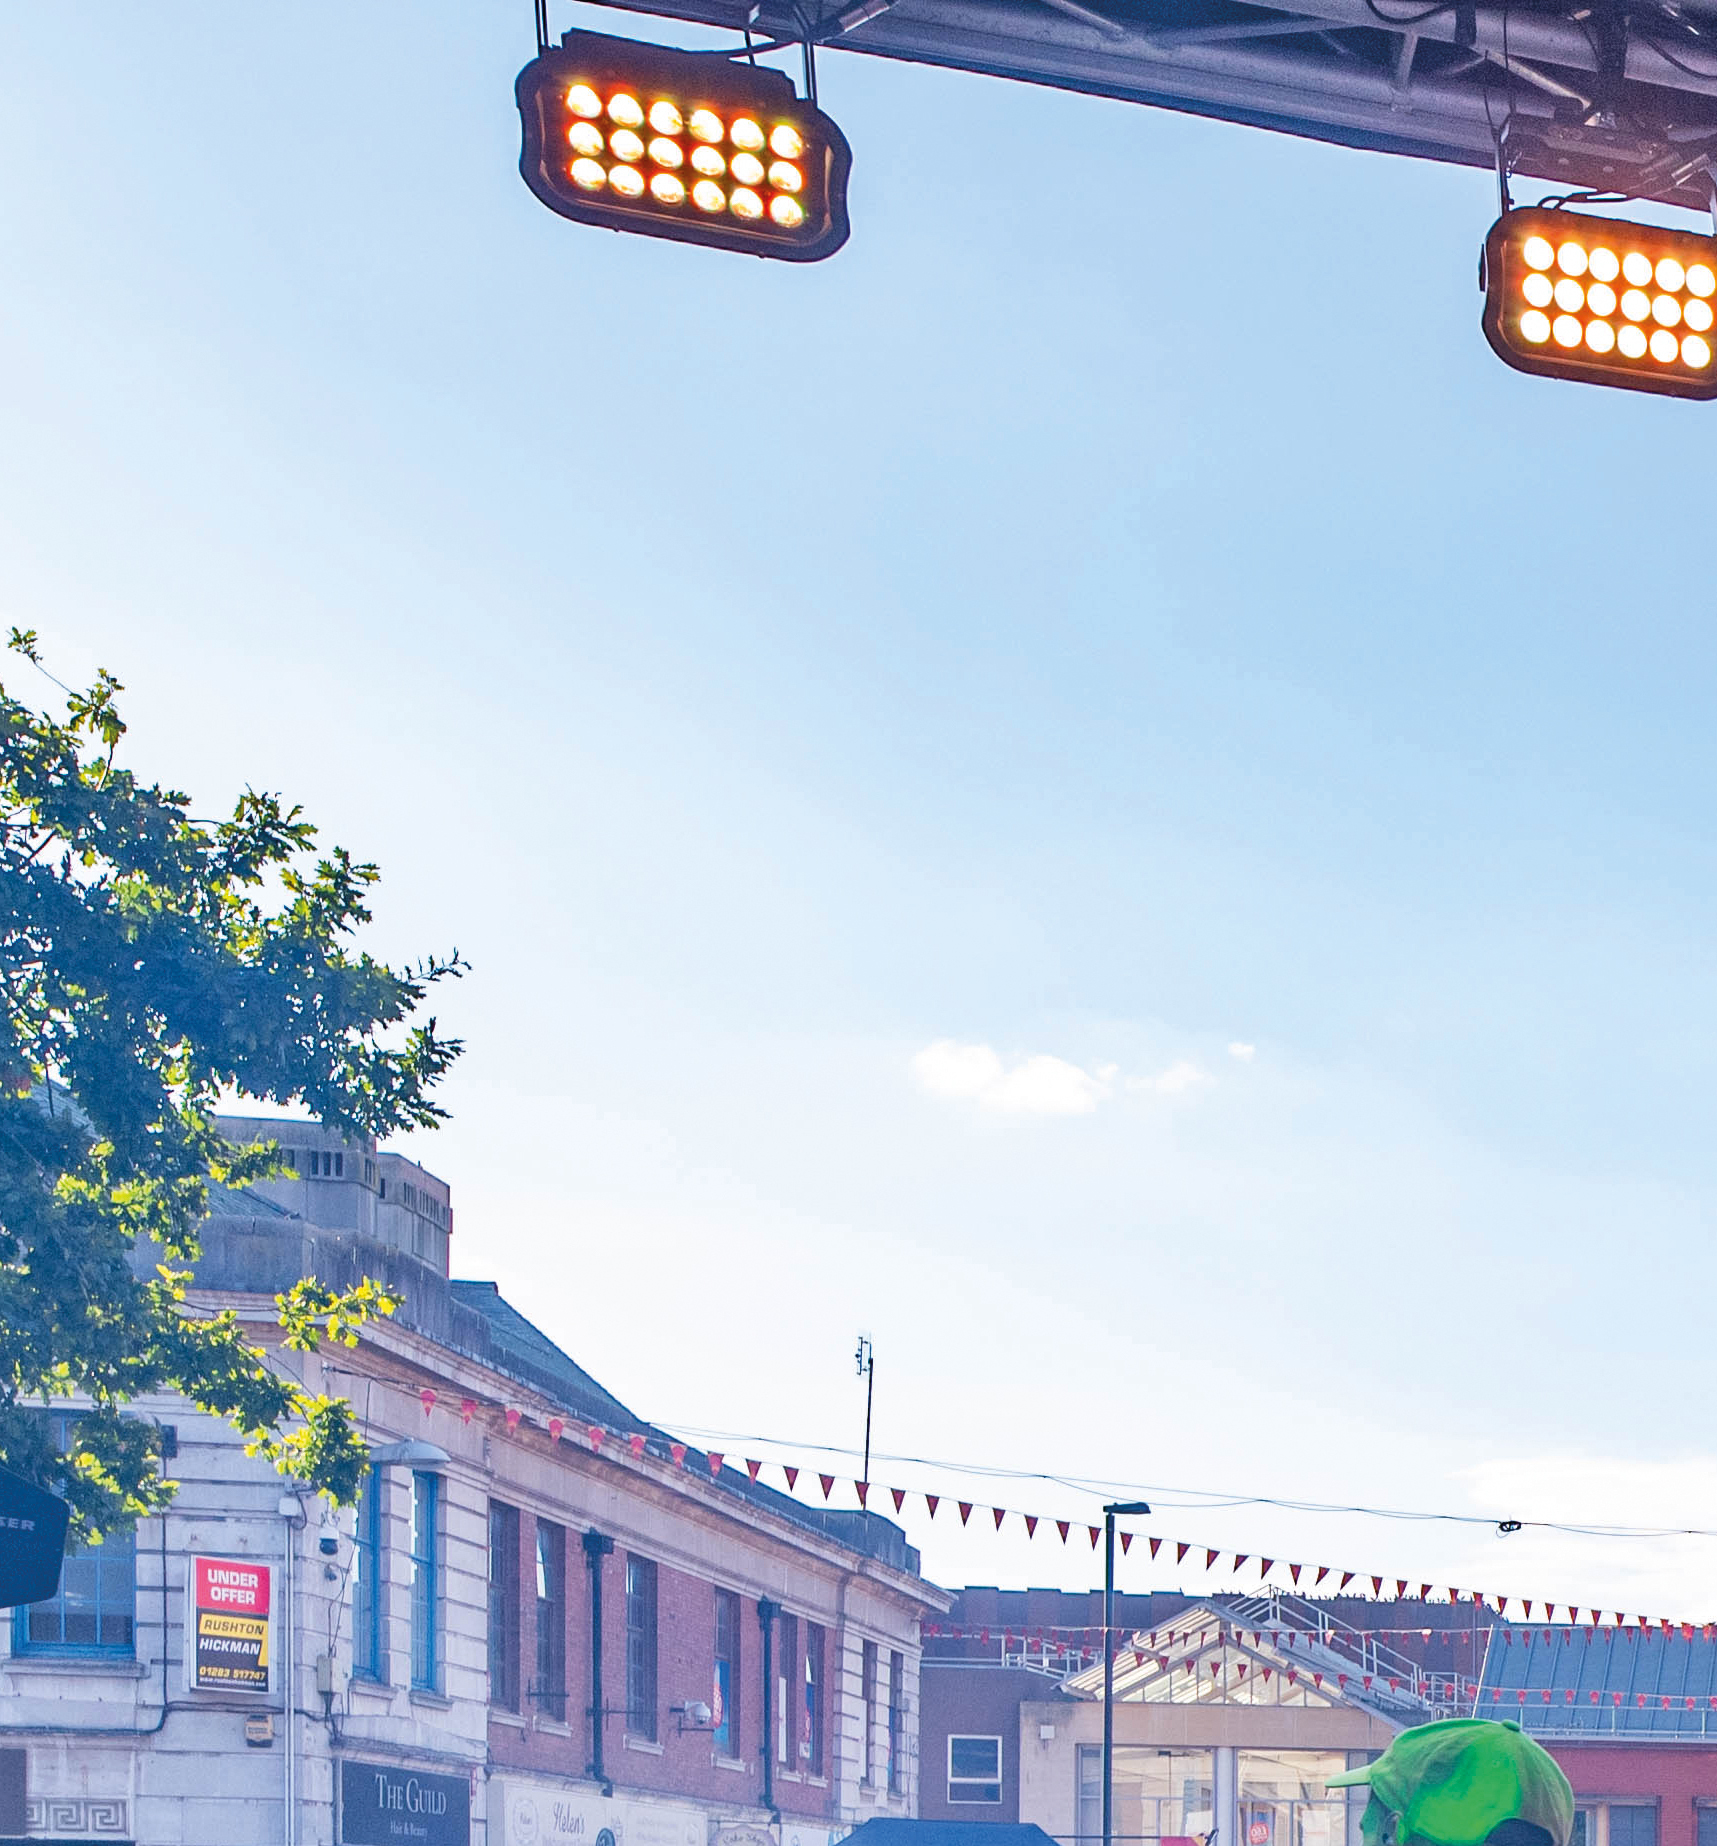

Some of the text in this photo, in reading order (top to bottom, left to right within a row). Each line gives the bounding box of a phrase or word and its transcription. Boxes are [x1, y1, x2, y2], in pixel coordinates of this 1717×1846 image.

[207, 1568, 258, 1588] UNDER
[210, 1586, 256, 1605] OFFER
[203, 1619, 265, 1635] RUSHTON
[199, 1637, 261, 1655] HICKMAN
[374, 1773, 447, 1815] THE GUILD
